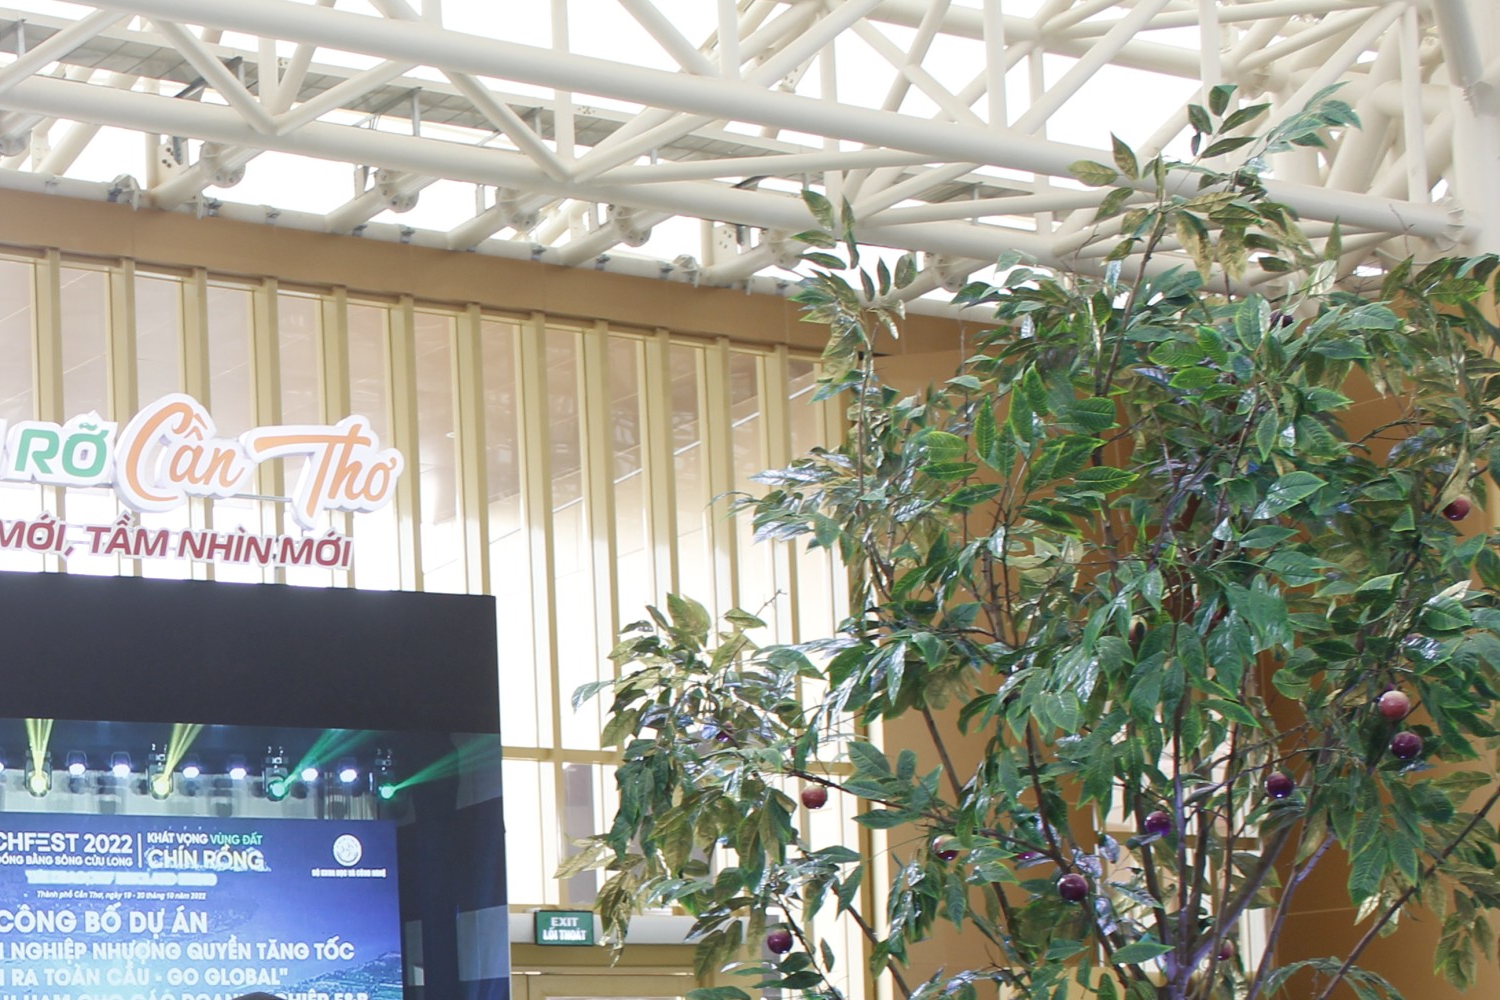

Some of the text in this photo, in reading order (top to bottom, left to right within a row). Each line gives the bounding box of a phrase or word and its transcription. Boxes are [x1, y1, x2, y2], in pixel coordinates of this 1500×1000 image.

[14, 422, 108, 479] RỠ
[125, 402, 246, 505] Cần
[253, 424, 399, 514] Thơ
[84, 512, 168, 557] TẦM
[177, 523, 274, 567] NHÌN
[279, 529, 353, 570] MỚI
[84, 834, 133, 853] 2022
[148, 831, 263, 847] KHÁT VỌNG VÙNG ĐẤT
[26, 852, 53, 866] BẰNG
[55, 852, 83, 867] SÔNG
[107, 856, 133, 868] LONG
[149, 844, 264, 871] CHÍN RỒNG
[85, 902, 121, 933] BỐ
[129, 907, 165, 939] DỰ
[171, 906, 208, 933] ÁN
[551, 917, 579, 927] EXIT
[12, 938, 87, 963] NGHIỆP
[92, 941, 182, 963] NHƯỢNG
[187, 935, 251, 960] QUYỀN
[256, 939, 310, 960] TĂNG
[313, 935, 355, 960] TỐC
[11, 967, 39, 987] RA
[44, 964, 100, 986] TOÀN
[106, 962, 150, 986] CẦU
[167, 967, 199, 986] GO
[205, 967, 288, 986] GLOBAL"
